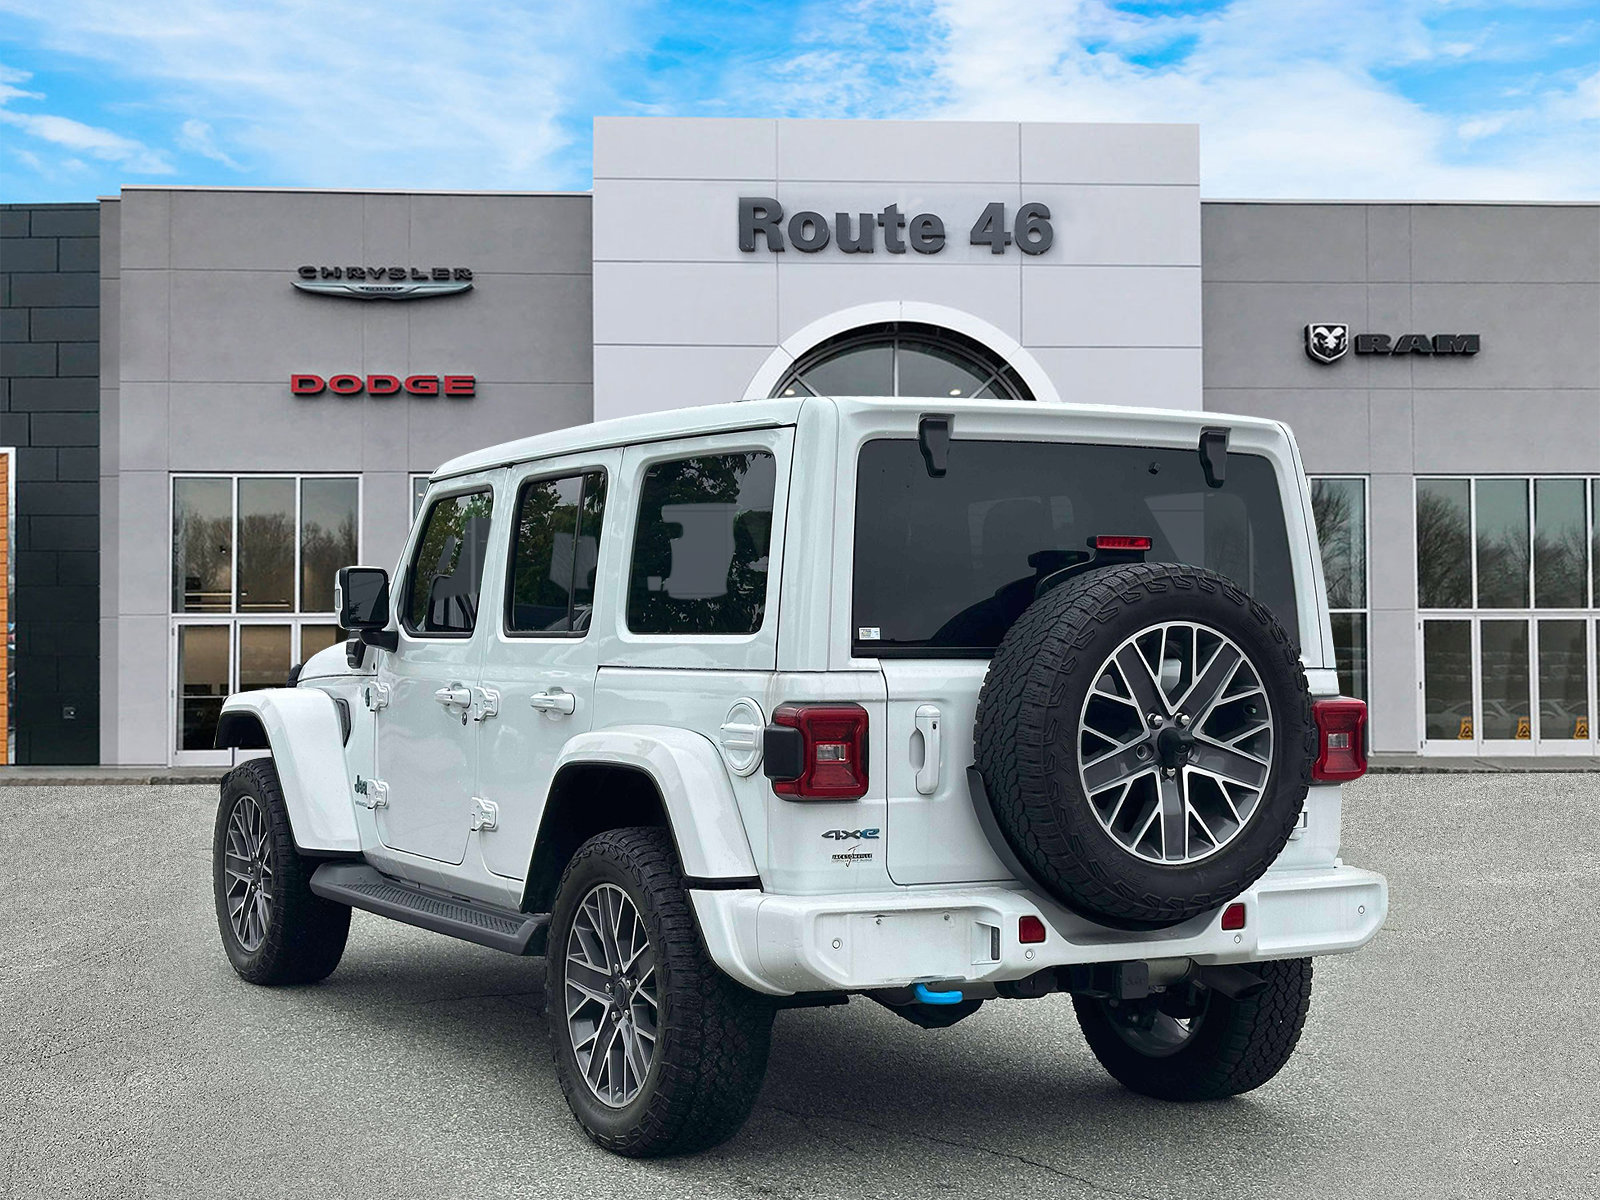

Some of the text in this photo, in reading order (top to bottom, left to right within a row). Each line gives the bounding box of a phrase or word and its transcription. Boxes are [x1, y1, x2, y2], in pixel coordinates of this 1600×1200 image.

[739, 197, 1054, 255] Route 46
[298, 266, 473, 281] CHRYSLER
[1354, 334, 1480, 354] RAM
[291, 374, 476, 397] DODGE
